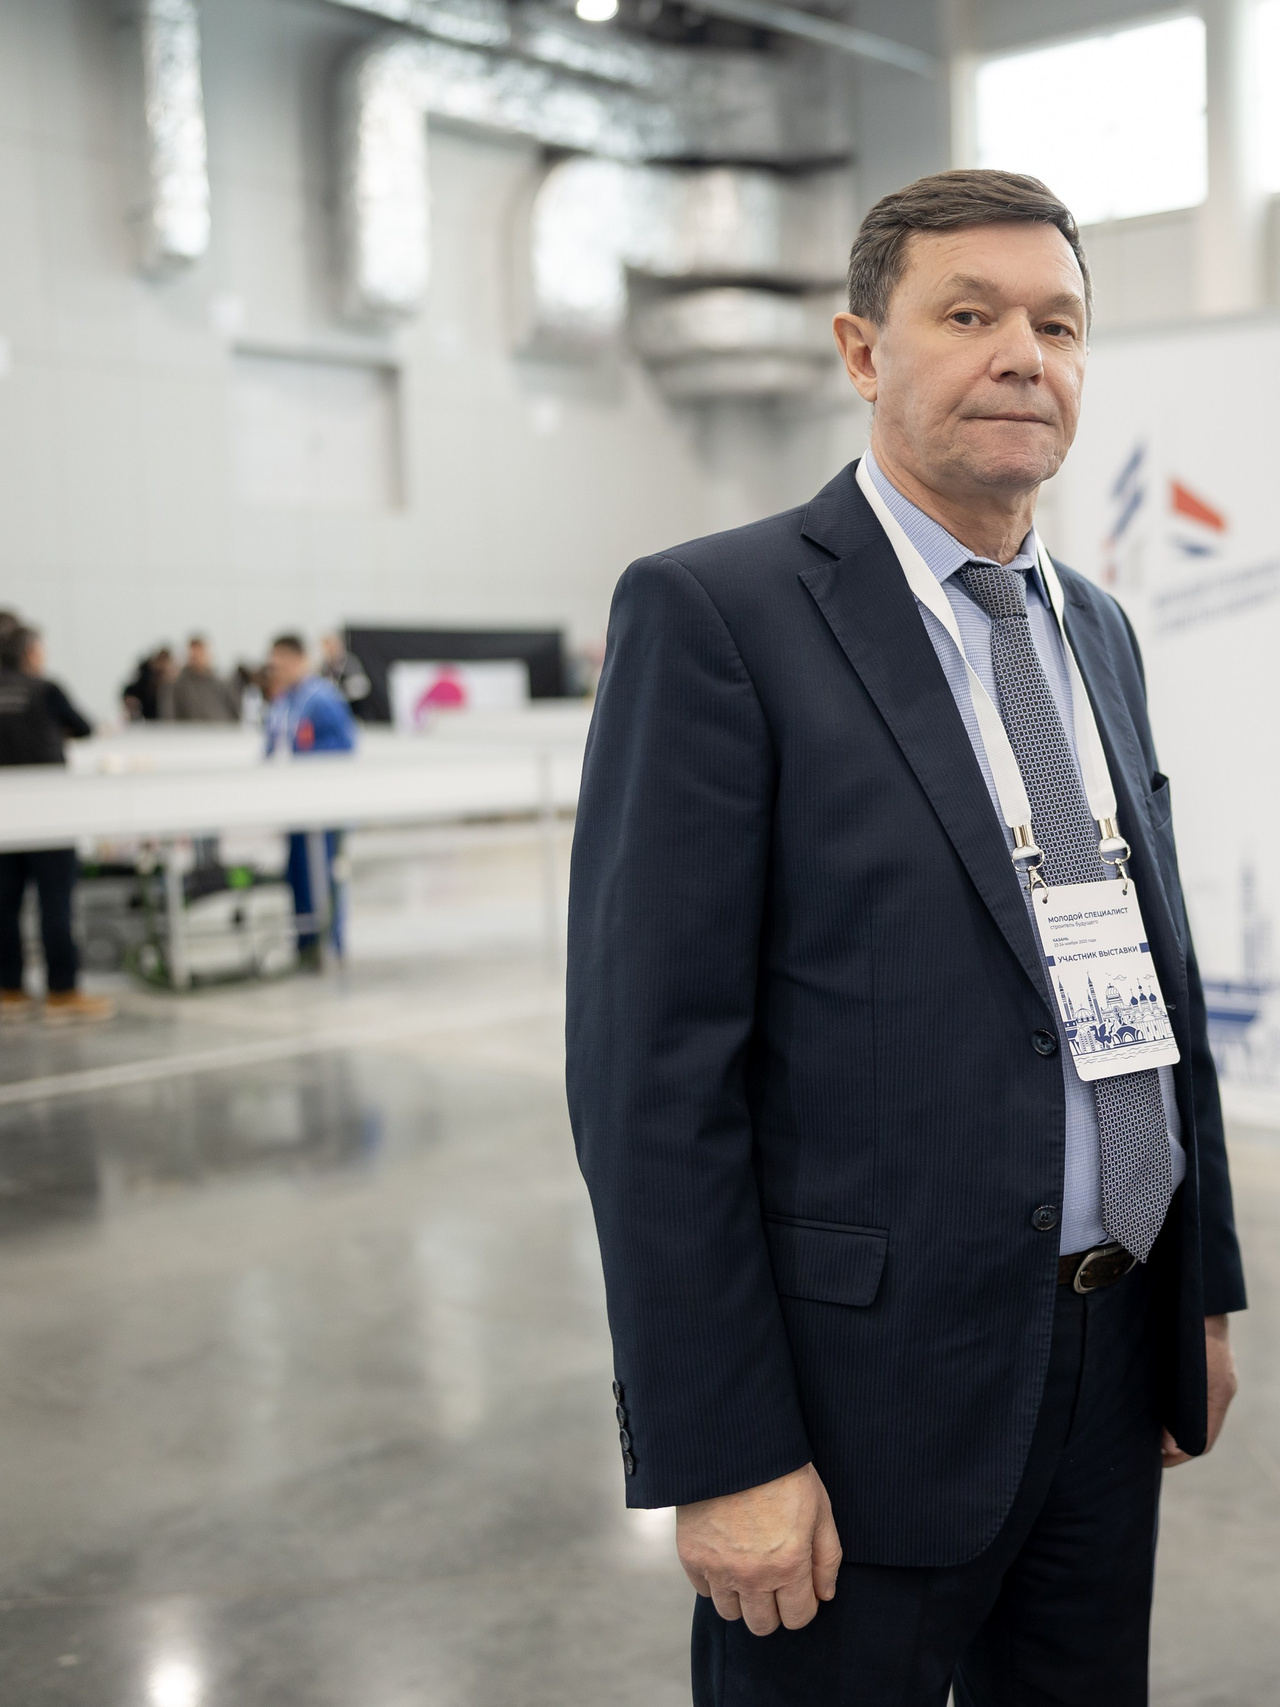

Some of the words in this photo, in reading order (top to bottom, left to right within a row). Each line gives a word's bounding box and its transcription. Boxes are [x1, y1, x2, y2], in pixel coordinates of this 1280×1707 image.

[1047, 912, 1083, 923] МОЛОДОЙ
[1083, 907, 1128, 919] СПЕЦИАЛИСТ
[1057, 951, 1098, 964] УЧАСТНИК
[1098, 946, 1139, 958] ВЫСТАВКИ
